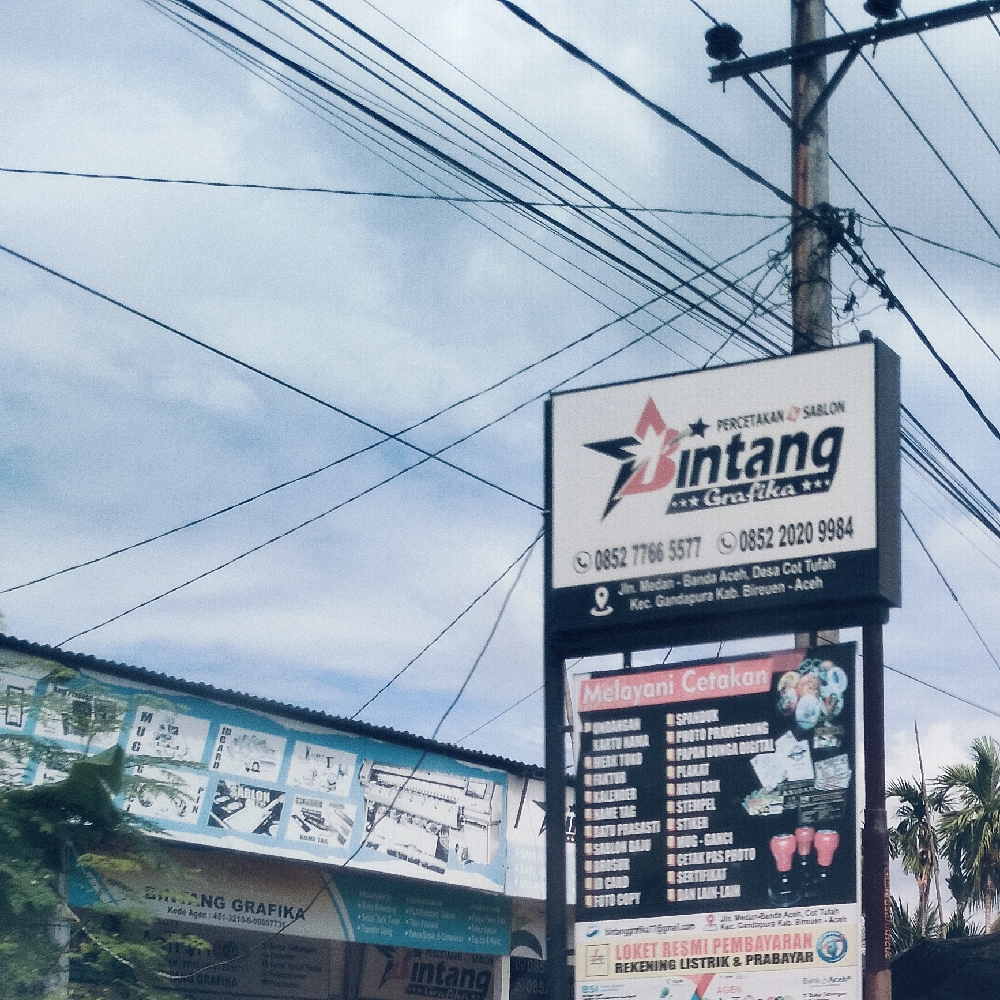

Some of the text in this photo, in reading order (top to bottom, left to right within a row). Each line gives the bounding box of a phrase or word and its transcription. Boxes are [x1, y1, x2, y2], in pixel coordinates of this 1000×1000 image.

[716, 400, 845, 432] PERCETAKAN SABLON
[640, 426, 845, 497] Bintang
[739, 516, 854, 553] 0852 2020 9984
[595, 548, 628, 572] 0852
[669, 536, 702, 562] 5577
[682, 571, 717, 587] Banda
[752, 564, 781, 579] Desa
[742, 582, 785, 598] Bireuen
[794, 576, 824, 591] Aceh
[582, 662, 769, 706] Melayani Cetakan
[131, 711, 154, 753] MUG
[191, 786, 205, 814] PIN
[676, 798, 717, 814] STEMPEL
[231, 899, 307, 921] GRAFIKA
[593, 893, 616, 908] FOTO
[615, 932, 813, 961] LOKET RESMI PEMBAYARAN
[614, 951, 814, 974] REKENING LISTRIK & PRABAYAR
